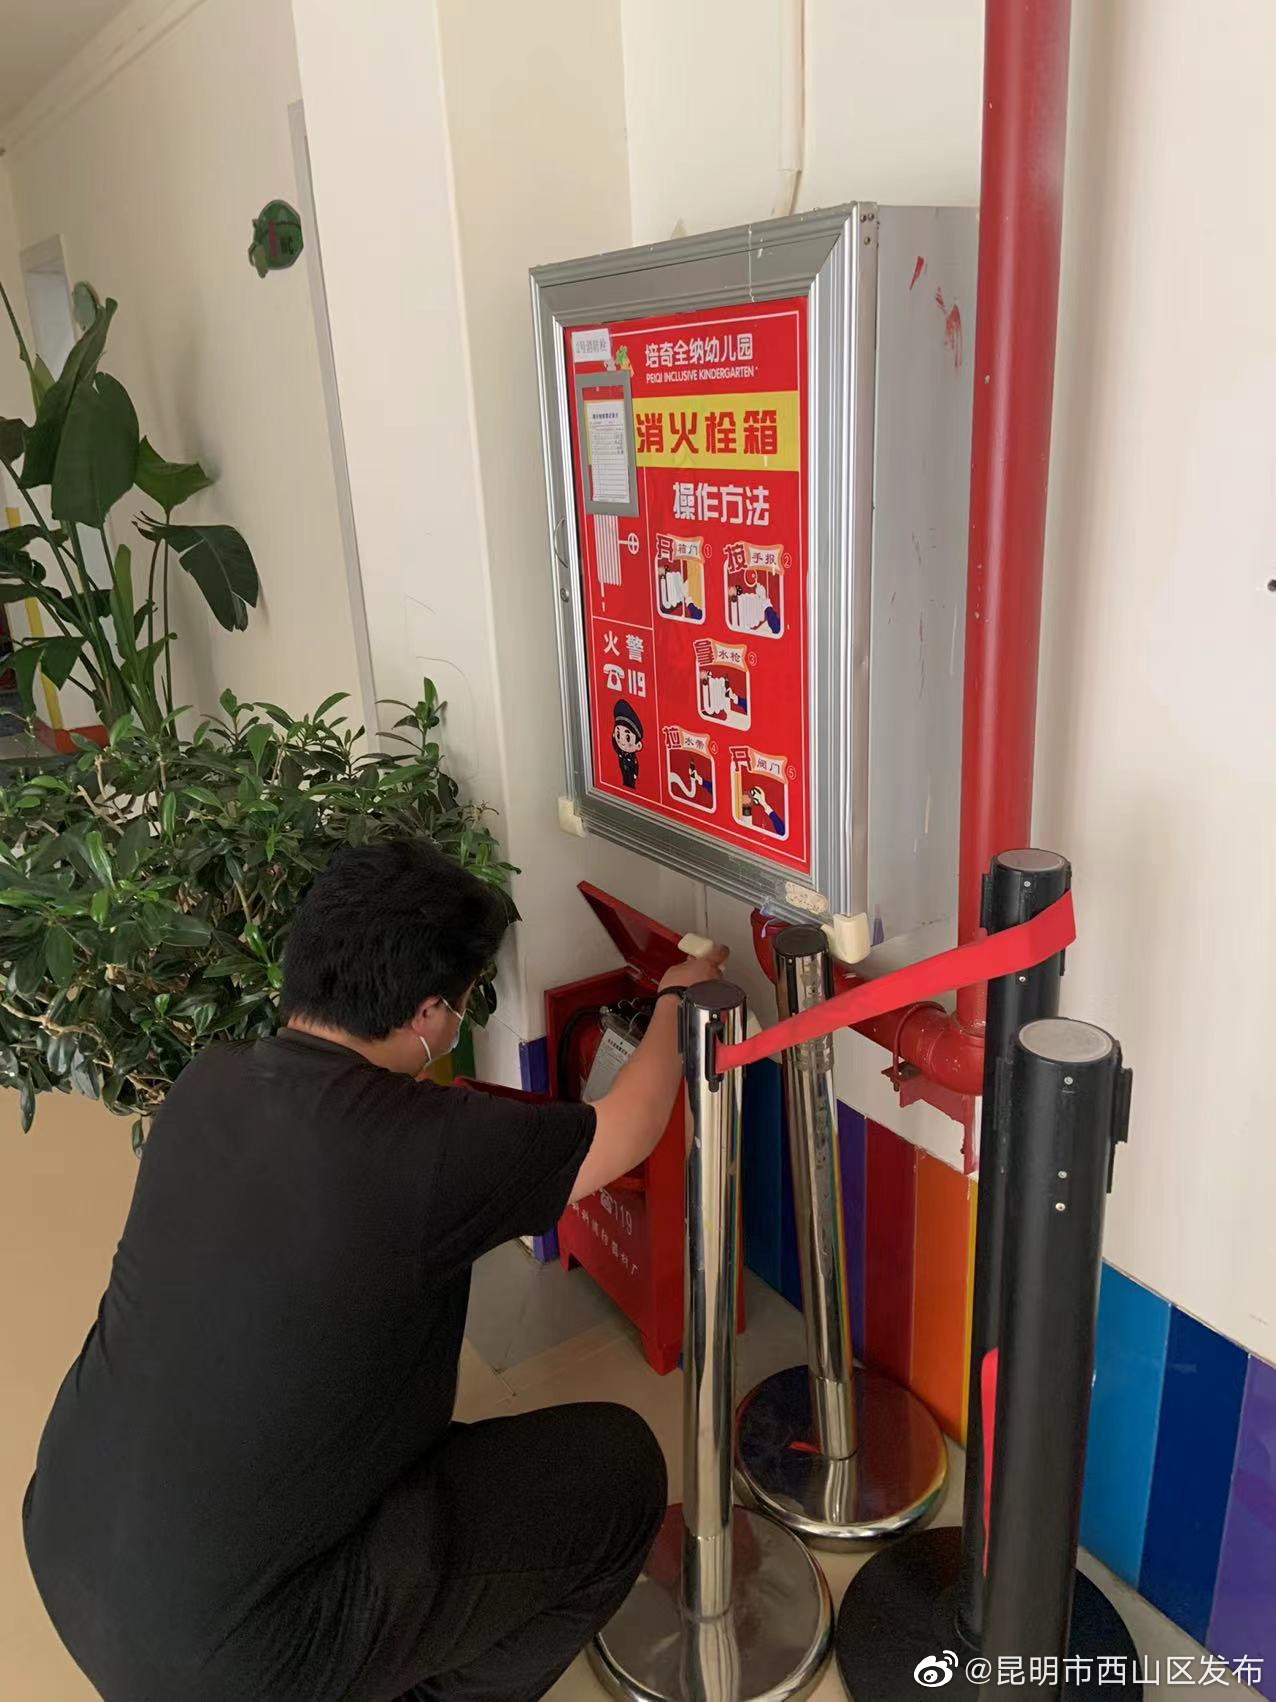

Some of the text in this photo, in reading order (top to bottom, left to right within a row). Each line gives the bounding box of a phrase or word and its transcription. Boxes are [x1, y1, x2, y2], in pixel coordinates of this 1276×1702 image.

[645, 333, 753, 369] 培奇全纳幼儿园
[646, 365, 754, 384] PEIQI INCLUSIVE KINDERGARTEN
[636, 409, 778, 455] 消火栓箱
[673, 481, 769, 526] 操作方法
[604, 630, 644, 663] 火警
[627, 668, 646, 698] 119
